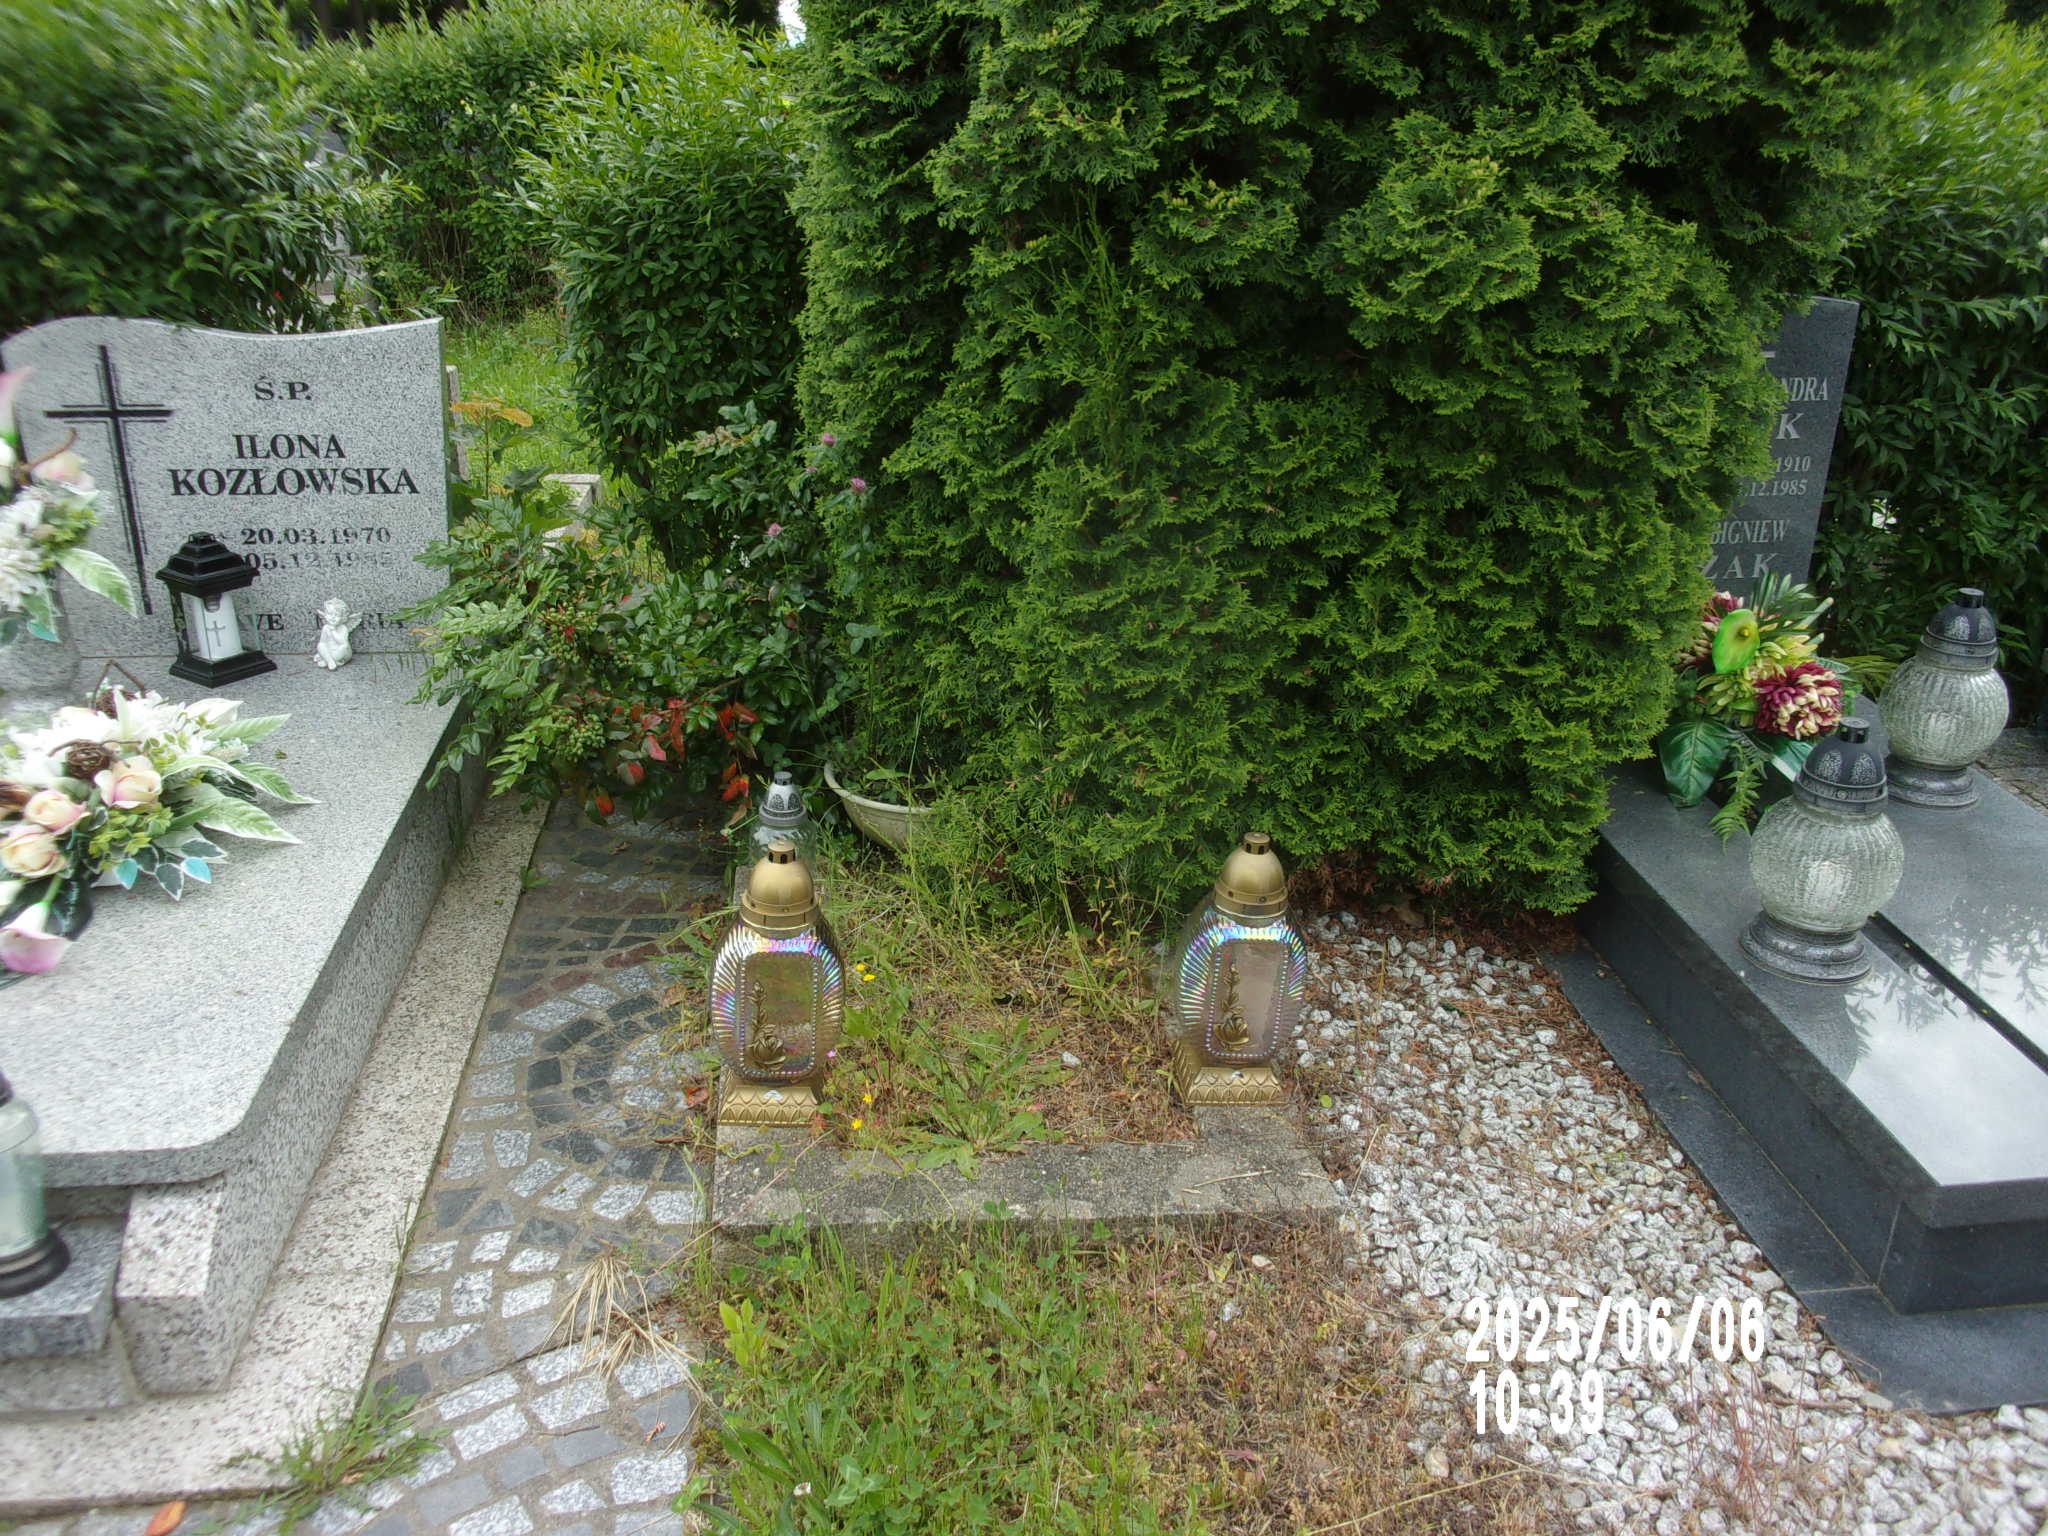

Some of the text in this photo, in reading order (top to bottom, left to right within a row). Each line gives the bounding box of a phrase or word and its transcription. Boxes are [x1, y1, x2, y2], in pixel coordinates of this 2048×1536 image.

[253, 375, 313, 401] Ś.P.
[231, 433, 347, 460] ILONA
[1775, 455, 1811, 473] 1910
[167, 466, 421, 497] KOZŁOWSKA
[240, 526, 392, 546] 20.03.1970
[1710, 519, 1790, 545] BIGNIEW
